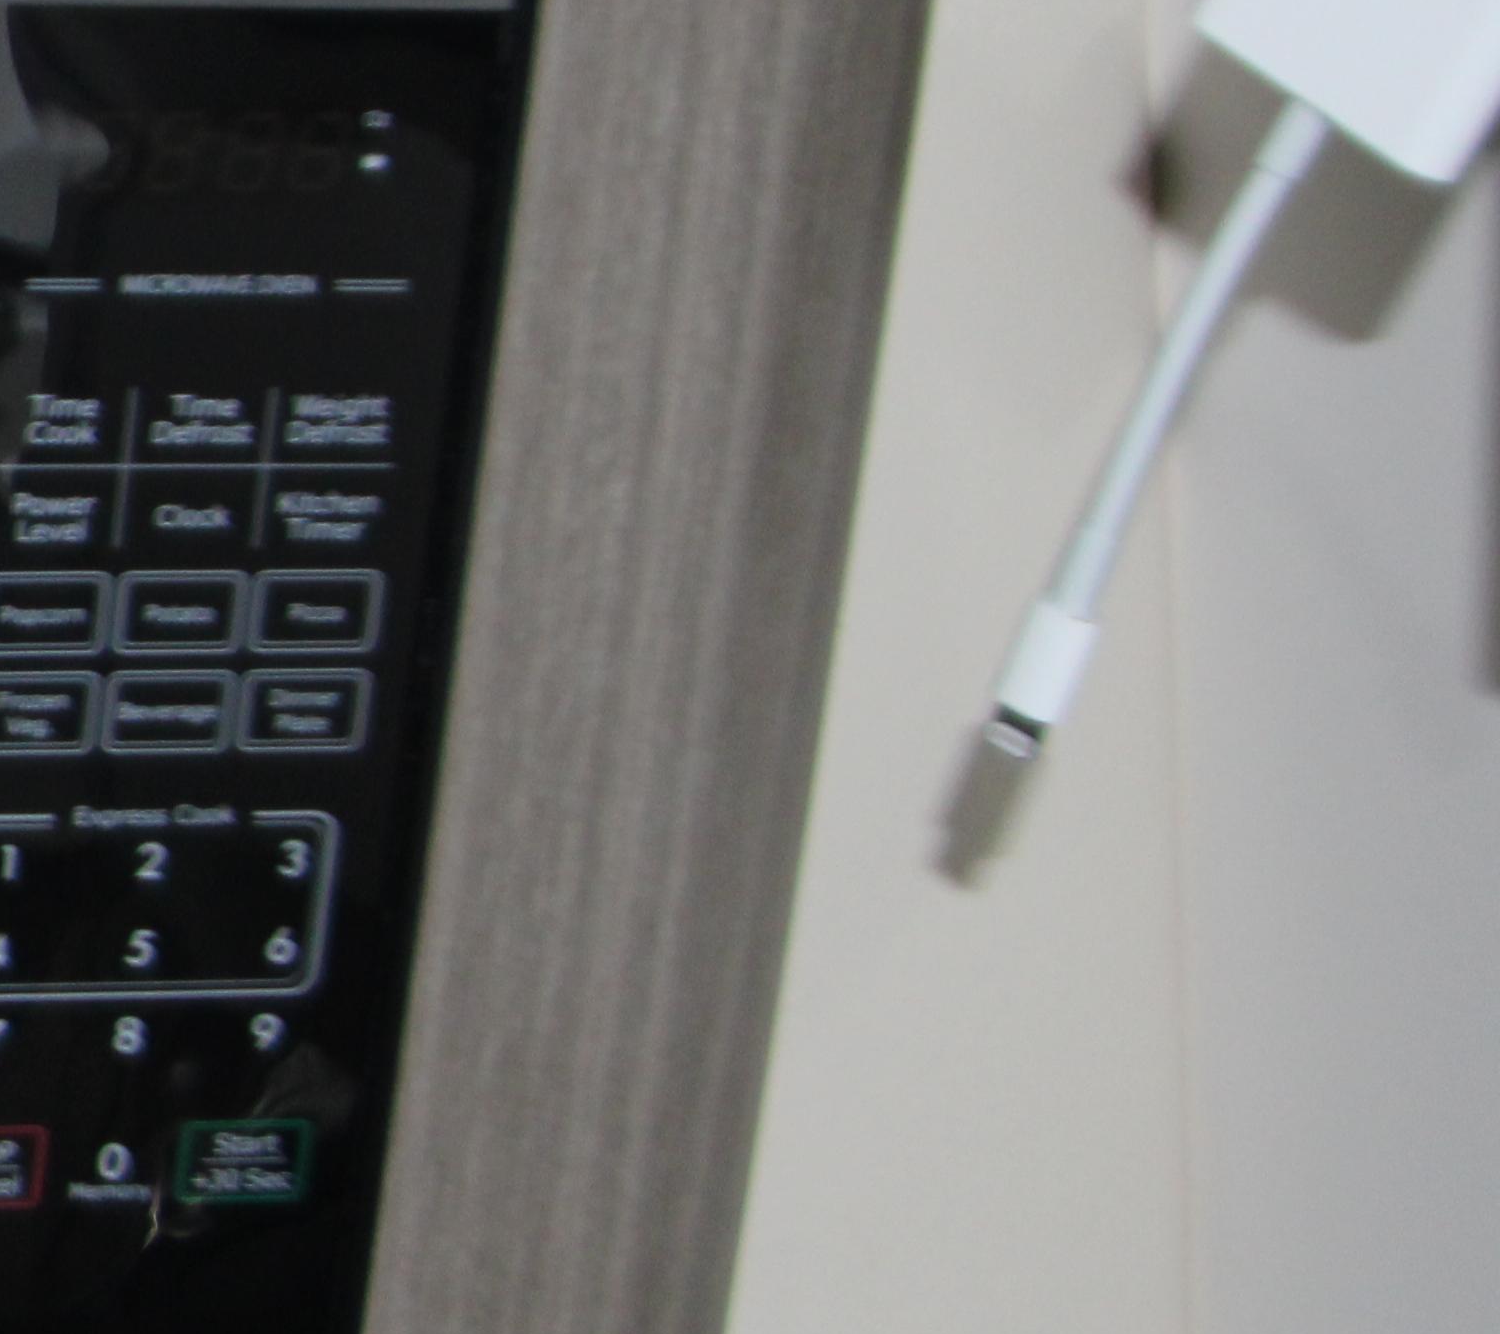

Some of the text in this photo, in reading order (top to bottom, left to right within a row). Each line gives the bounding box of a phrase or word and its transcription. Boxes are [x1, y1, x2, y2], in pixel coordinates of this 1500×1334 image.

[27, 394, 99, 421] Time
[169, 394, 240, 421] Time
[291, 395, 390, 424] Weight
[24, 421, 97, 446] Cook
[150, 421, 254, 446] Defrost
[286, 421, 389, 446] Defrost
[11, 493, 97, 518] Power
[153, 504, 231, 530] Clock
[14, 519, 90, 544] Level
[285, 517, 367, 542] Timer
[173, 804, 237, 827] Cook
[0, 837, 311, 882] 1 2 3
[124, 929, 158, 969] 5
[265, 926, 299, 966] 6
[113, 1016, 147, 1056] 8
[251, 1013, 286, 1051] 9
[212, 1132, 281, 1155] Start
